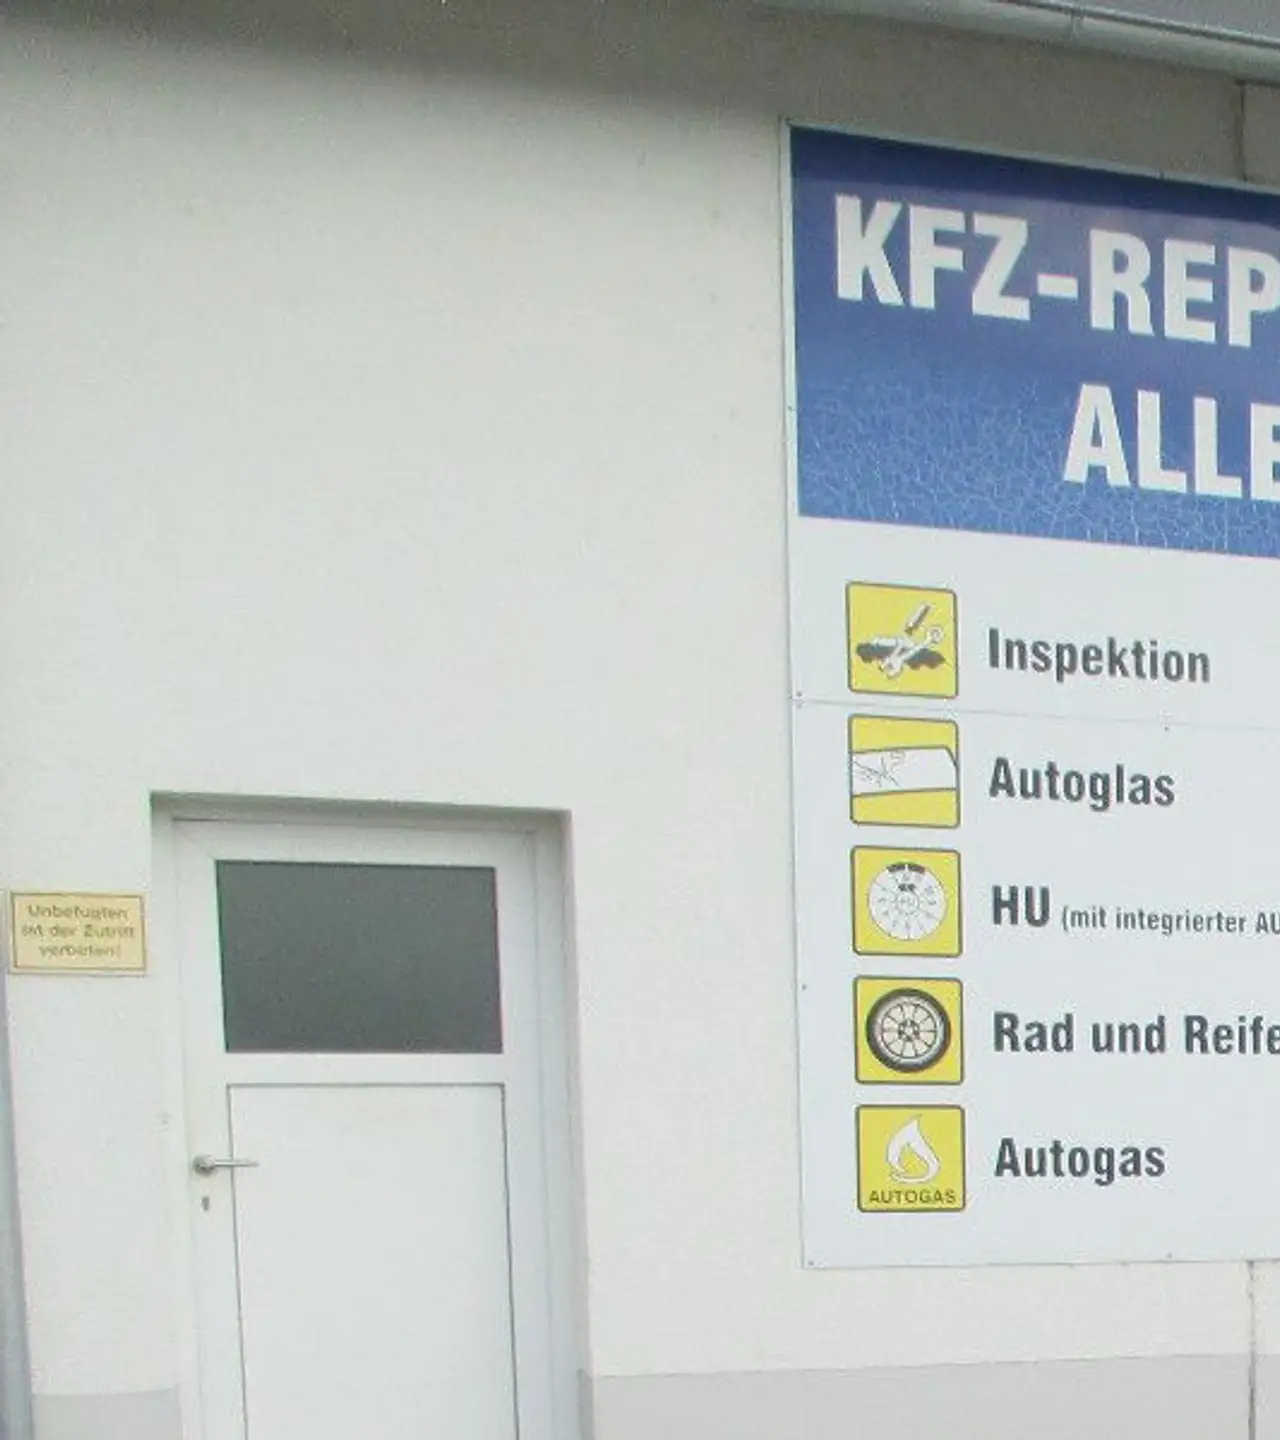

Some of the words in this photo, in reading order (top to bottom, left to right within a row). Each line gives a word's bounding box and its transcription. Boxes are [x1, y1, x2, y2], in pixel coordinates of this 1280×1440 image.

[988, 628, 1211, 683] Inspektion
[989, 757, 1176, 812] Autoglas
[27, 904, 128, 920] Unbefugten
[991, 885, 1051, 927] HU
[1062, 905, 1107, 930] (mit
[1116, 909, 1246, 936] integrierter
[993, 1011, 1074, 1053] Rad
[1091, 1015, 1166, 1053] und
[994, 1136, 1166, 1186] Autogas
[868, 1188, 957, 1205] AUTOGAS
